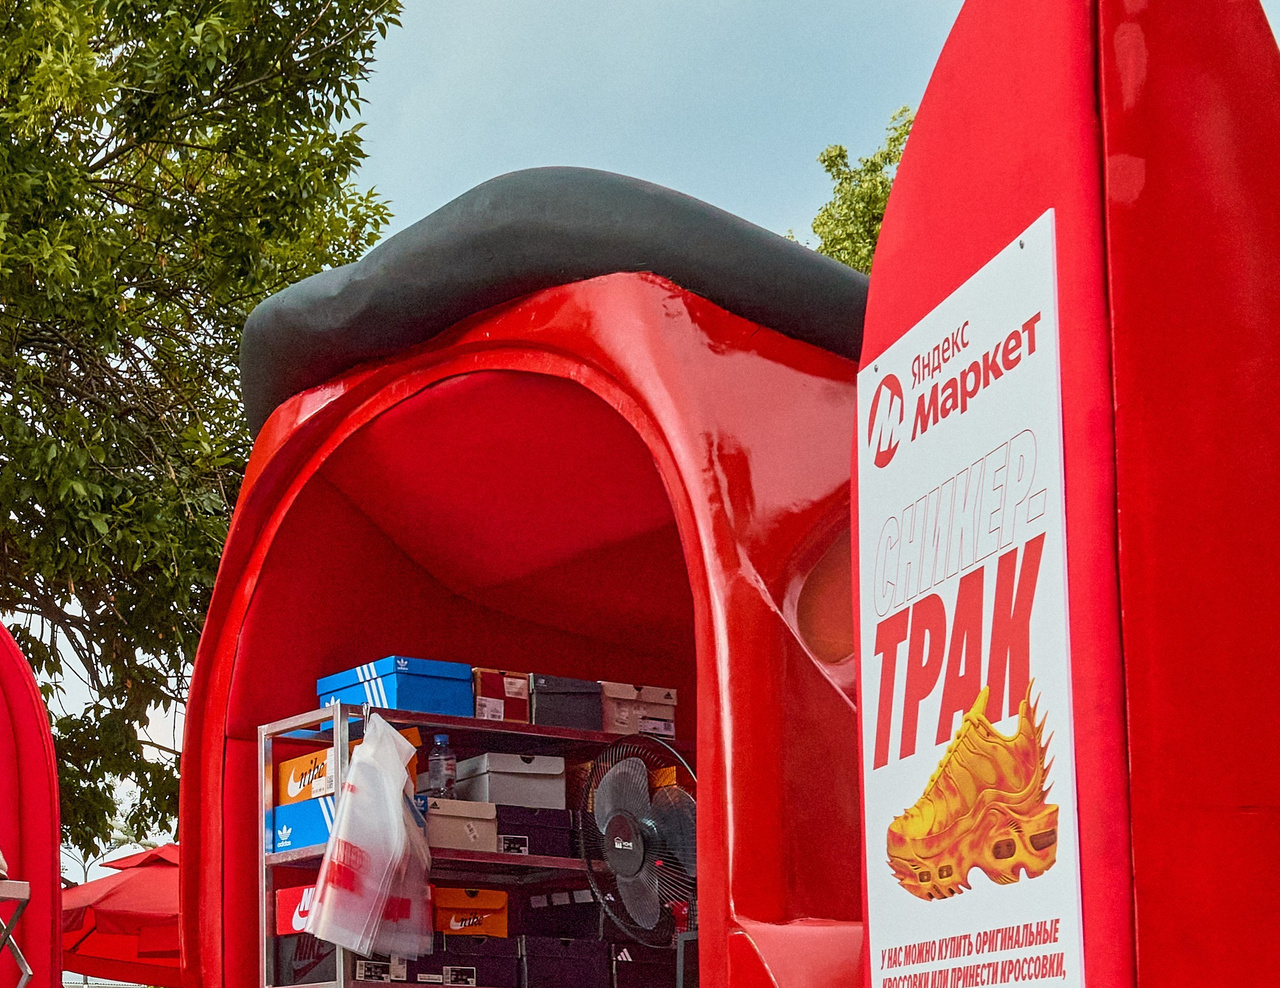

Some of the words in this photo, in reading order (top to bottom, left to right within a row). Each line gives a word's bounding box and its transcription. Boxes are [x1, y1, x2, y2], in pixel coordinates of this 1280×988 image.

[911, 310, 1041, 442] Маркет
[912, 320, 969, 389] Яндекс
[873, 531, 1047, 770] ТРАК
[880, 949, 886, 970] У
[887, 947, 903, 969] НАС
[904, 940, 936, 966] МОЖНО
[937, 934, 973, 962] КУПИТЬ
[975, 918, 1060, 955] ОРИГИНАЛЬНЫЕ
[950, 962, 999, 988] ПРИНЕСТИ
[1000, 952, 1066, 984] КРОССОВКИ,
